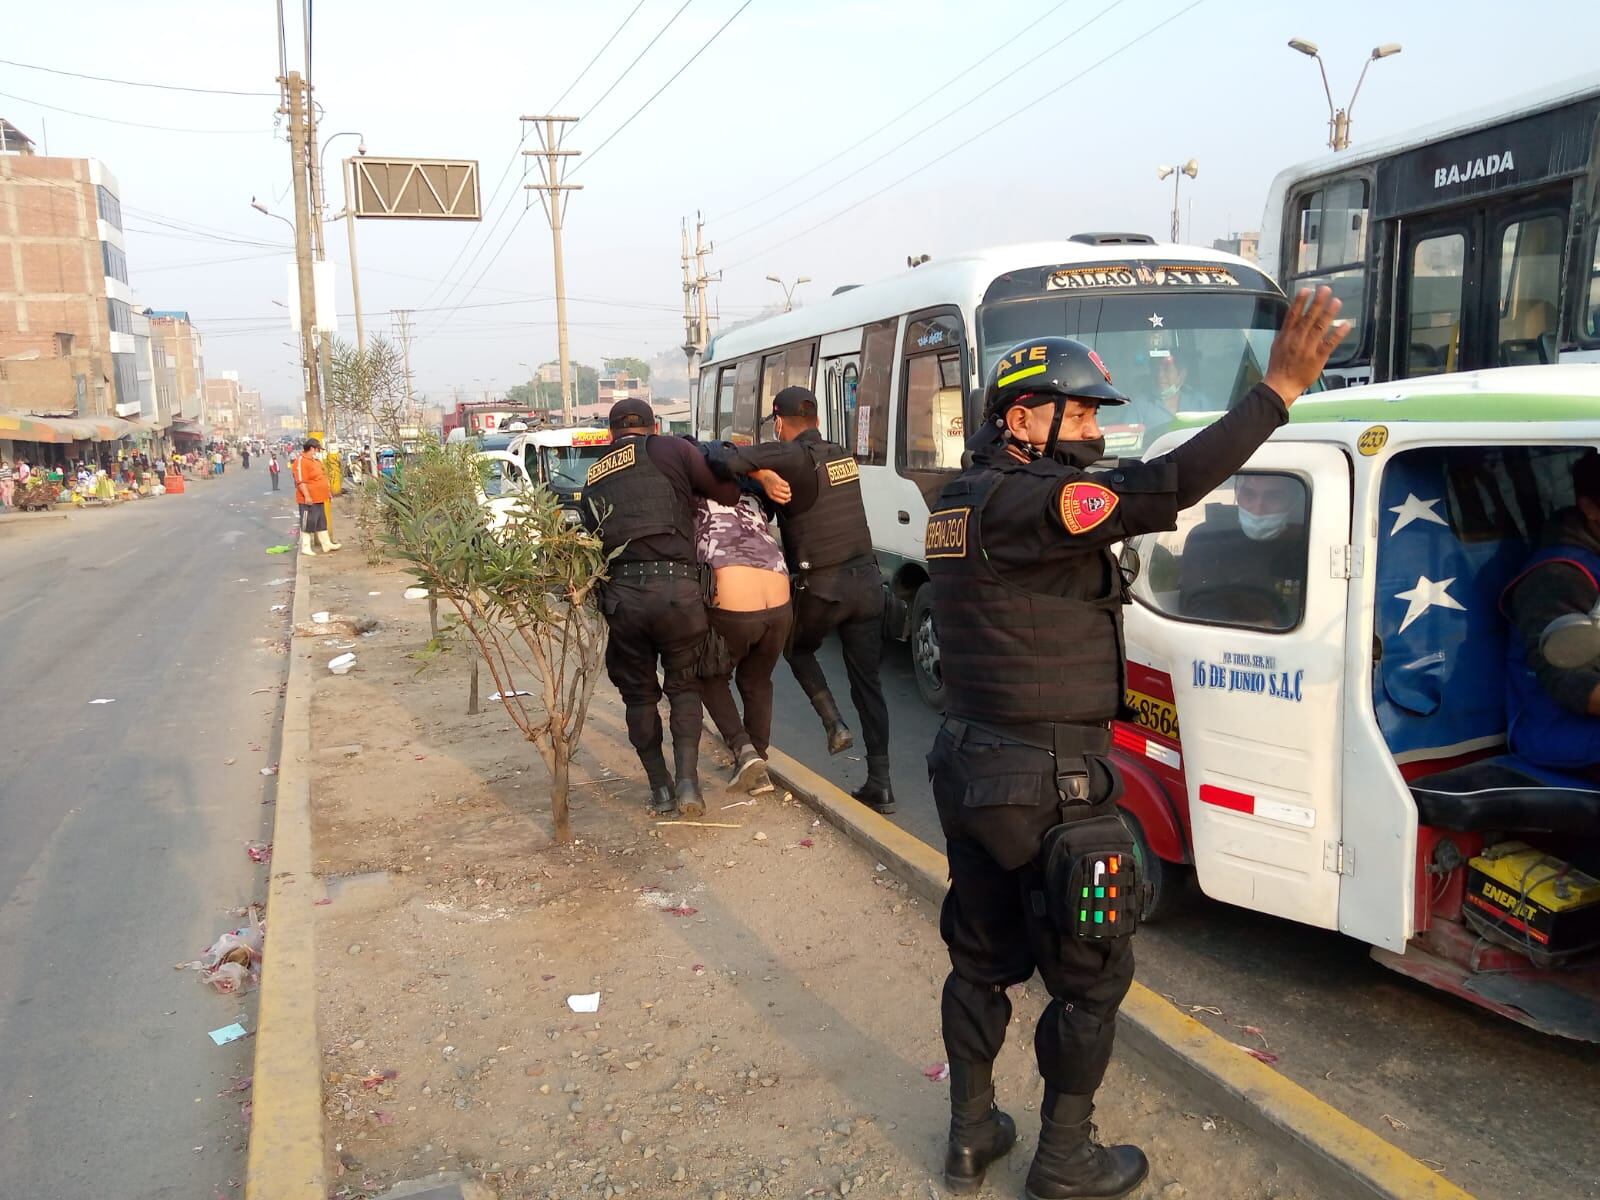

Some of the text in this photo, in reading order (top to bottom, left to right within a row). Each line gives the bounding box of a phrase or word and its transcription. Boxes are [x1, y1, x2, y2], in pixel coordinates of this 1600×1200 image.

[1434, 150, 1515, 189] BAJADA
[1051, 271, 1229, 290] CALLAO ATE
[997, 345, 1048, 377] ATE
[1360, 431, 1386, 448] 233
[589, 447, 633, 481] SERENAZGO
[1072, 499, 1081, 515] GIR
[1192, 659, 1206, 687] 16
[1209, 663, 1225, 688] DE
[1228, 669, 1266, 692] JUNIO
